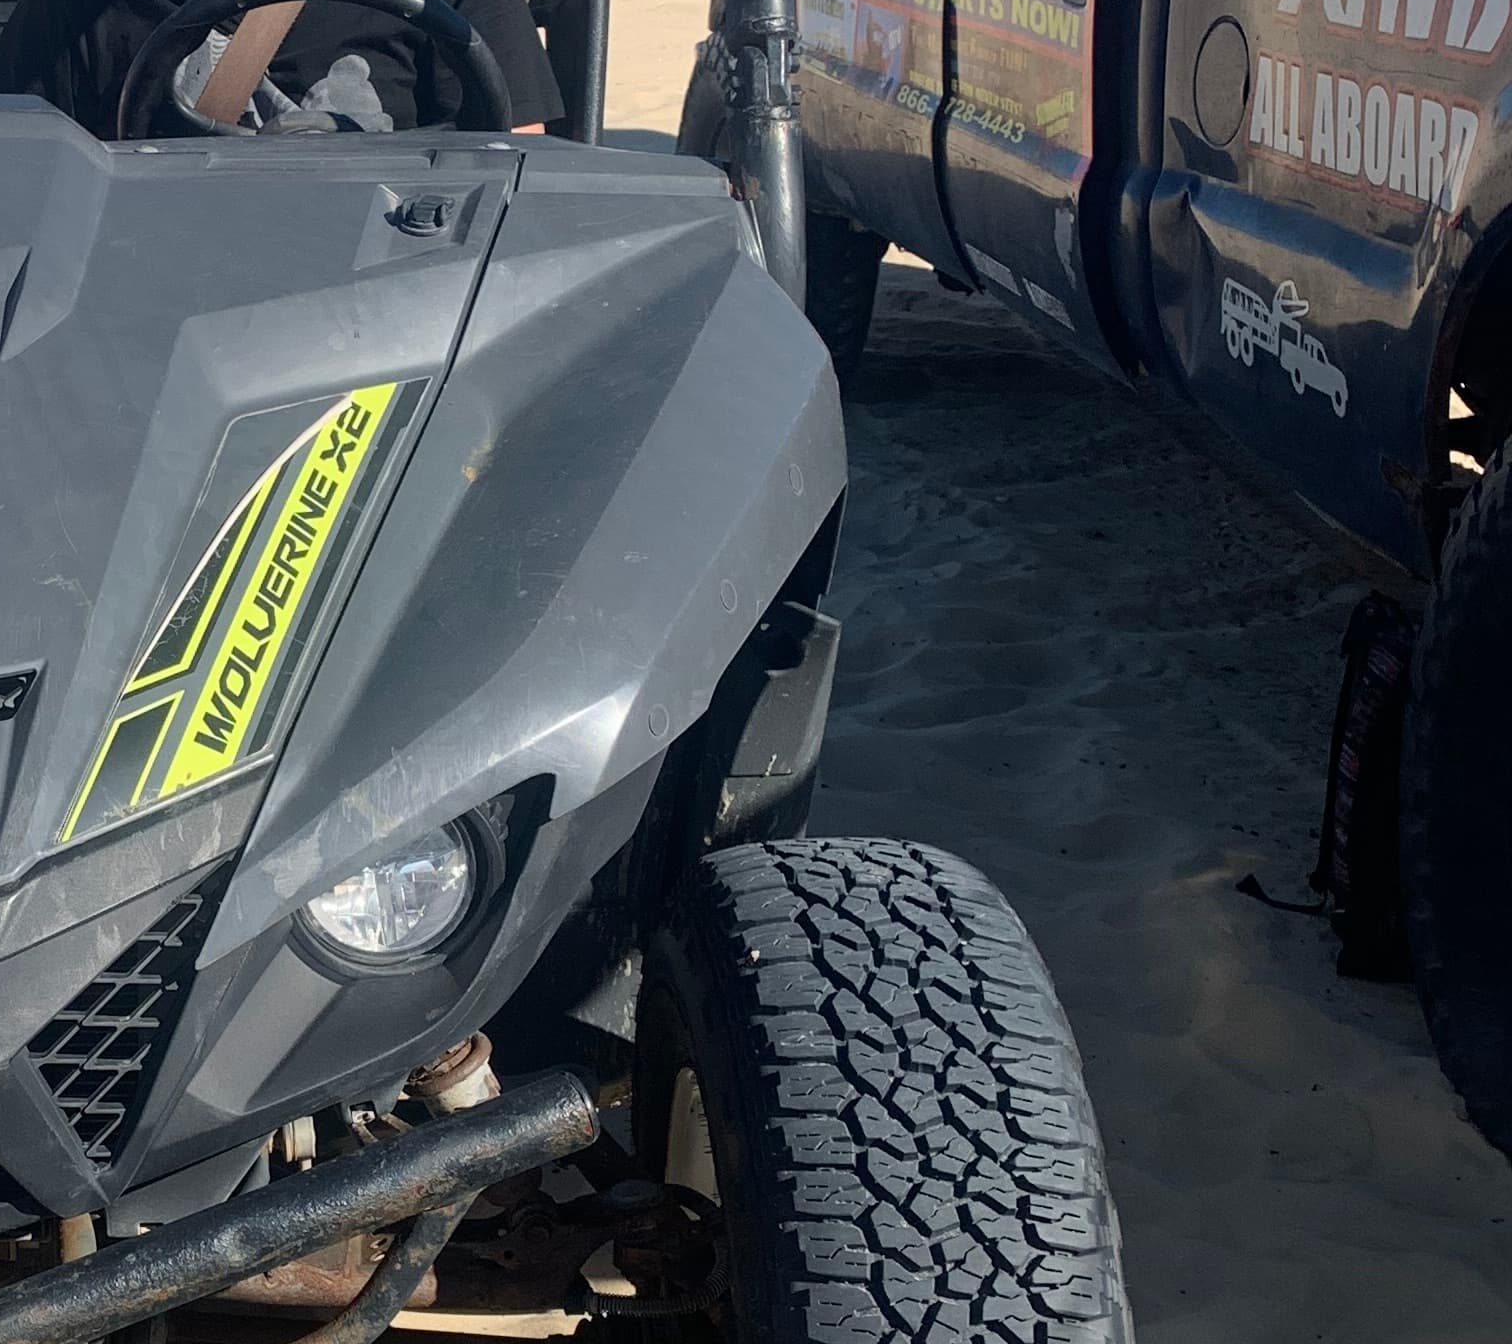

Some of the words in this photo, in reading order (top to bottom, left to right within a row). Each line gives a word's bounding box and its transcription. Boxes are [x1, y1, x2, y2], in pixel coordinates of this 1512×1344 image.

[1248, 55, 1305, 160] ALL
[1310, 71, 1480, 214] ABOARD
[193, 467, 339, 755] WOLVERINE
[319, 400, 373, 474] X2
